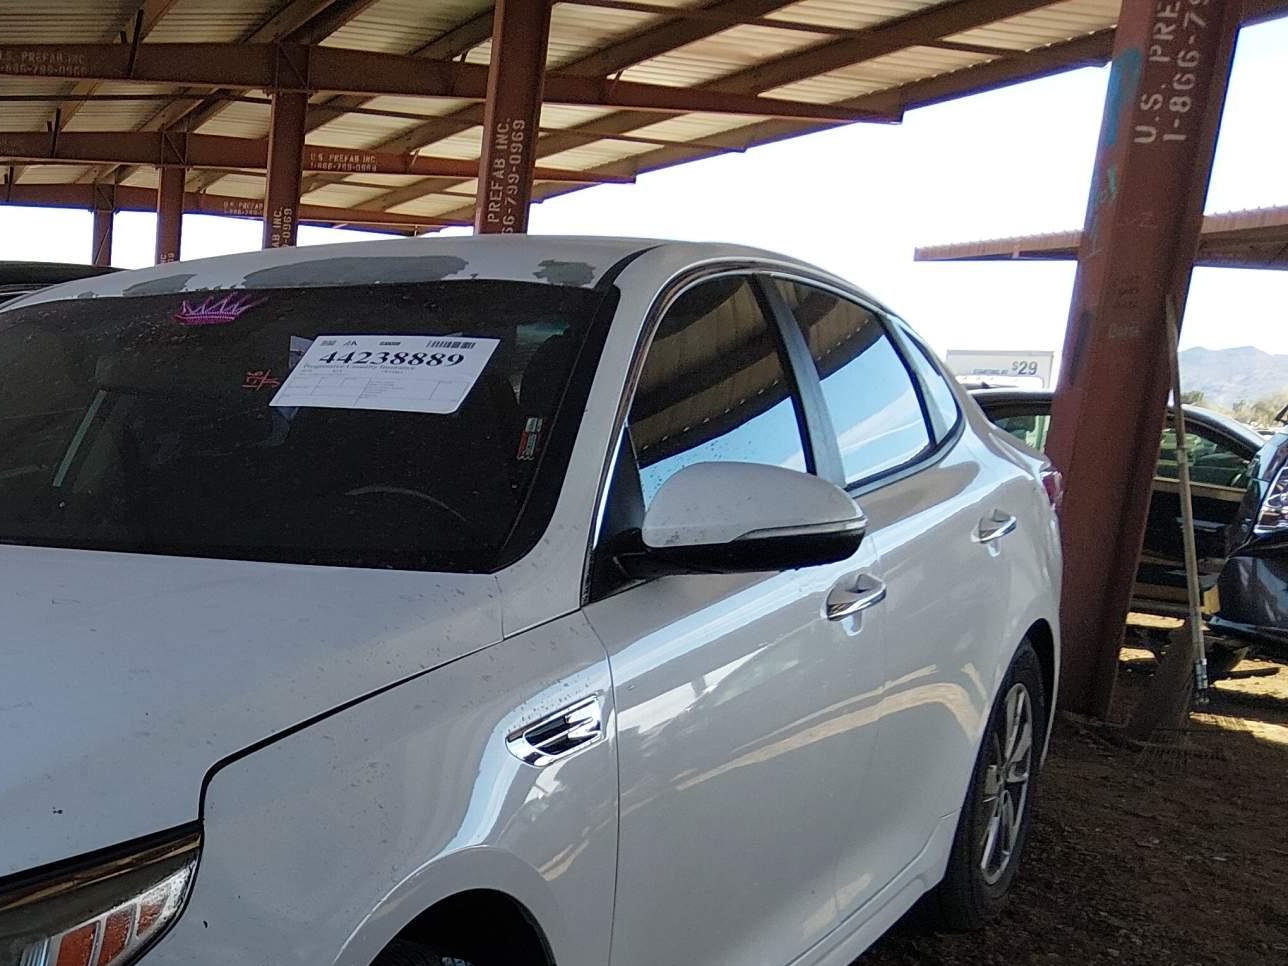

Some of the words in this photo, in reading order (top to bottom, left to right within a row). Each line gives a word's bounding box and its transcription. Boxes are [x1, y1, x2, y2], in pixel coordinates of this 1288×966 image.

[1149, 0, 1182, 62] PRE
[1162, 0, 1209, 141] 1-866-7
[496, 117, 511, 150] INC.
[1134, 83, 1166, 144] U.S.
[488, 158, 507, 223] PREFAB
[502, 119, 526, 235] 66-799-0969
[319, 351, 465, 367] 44238889
[1012, 360, 1038, 375] $29
